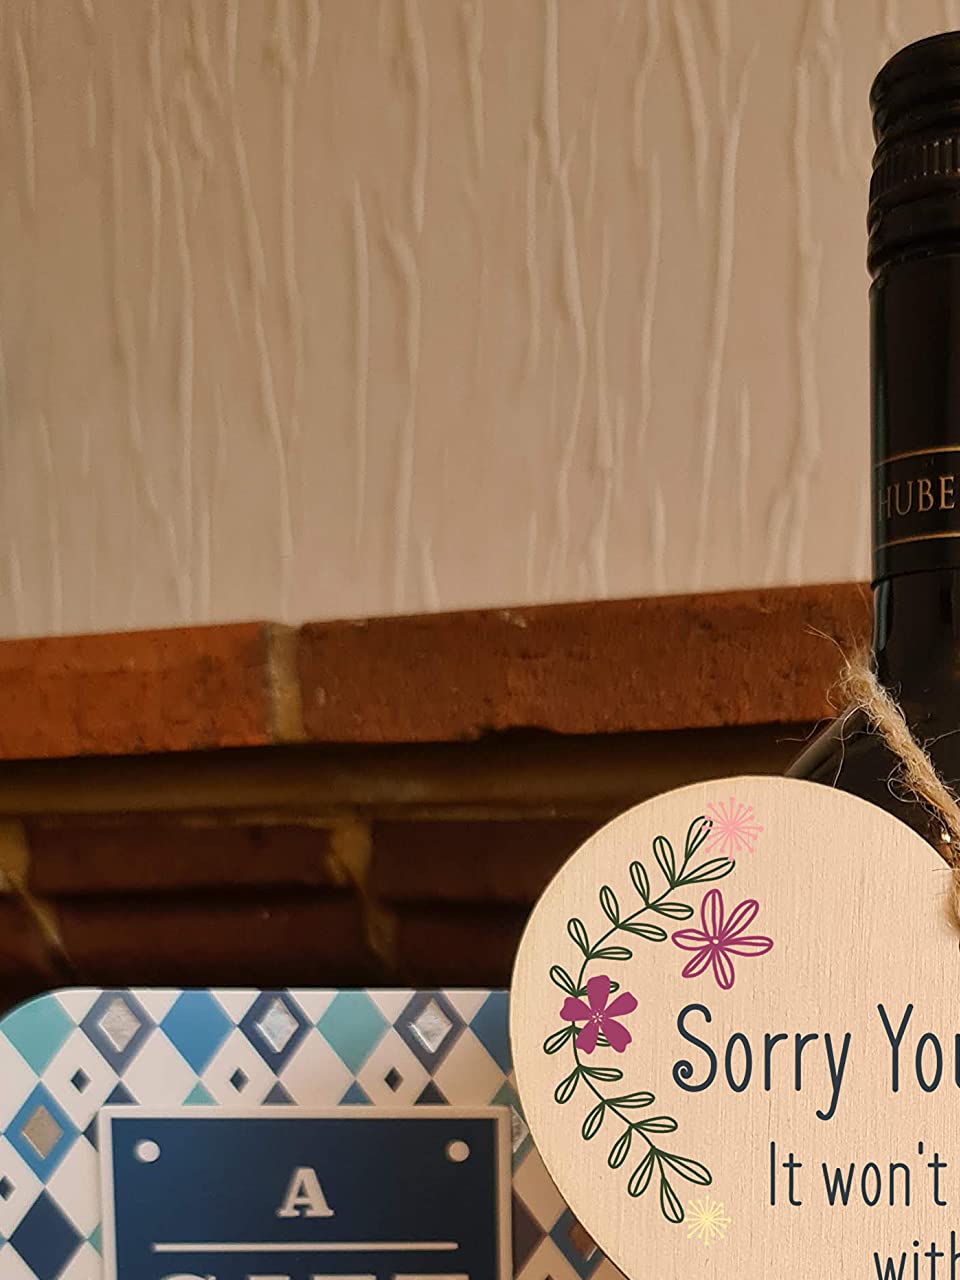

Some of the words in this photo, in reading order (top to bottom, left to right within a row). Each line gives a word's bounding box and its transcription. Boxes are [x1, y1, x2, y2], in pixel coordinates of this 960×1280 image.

[672, 1003, 851, 1121] Sorry
[276, 1166, 335, 1218] A
[770, 1140, 803, 1206] It
[821, 1140, 948, 1207] won't
